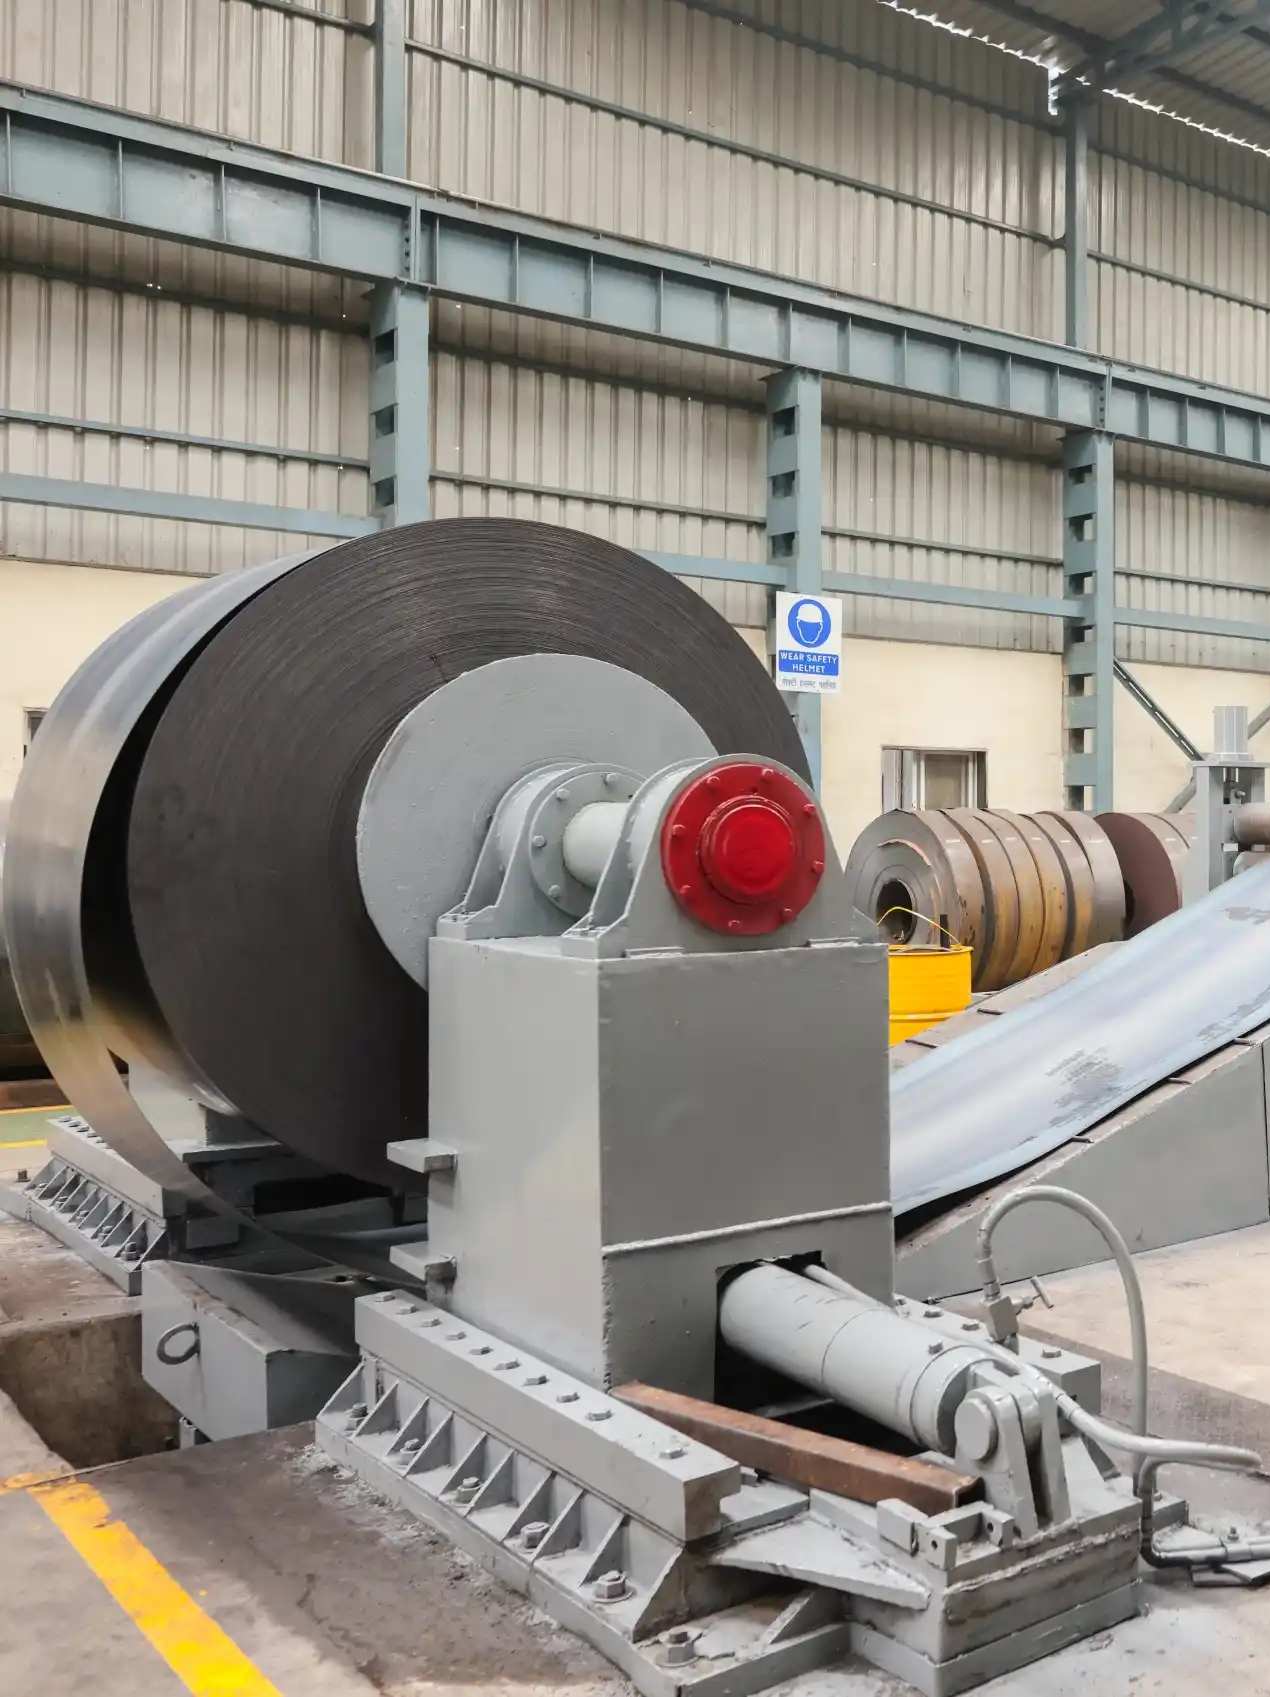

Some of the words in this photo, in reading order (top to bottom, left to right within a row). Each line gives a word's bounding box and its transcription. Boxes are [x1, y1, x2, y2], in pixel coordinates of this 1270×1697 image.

[781, 652, 804, 661] WEAR
[806, 654, 837, 664] SAFETY
[792, 664, 825, 673] HELMET
